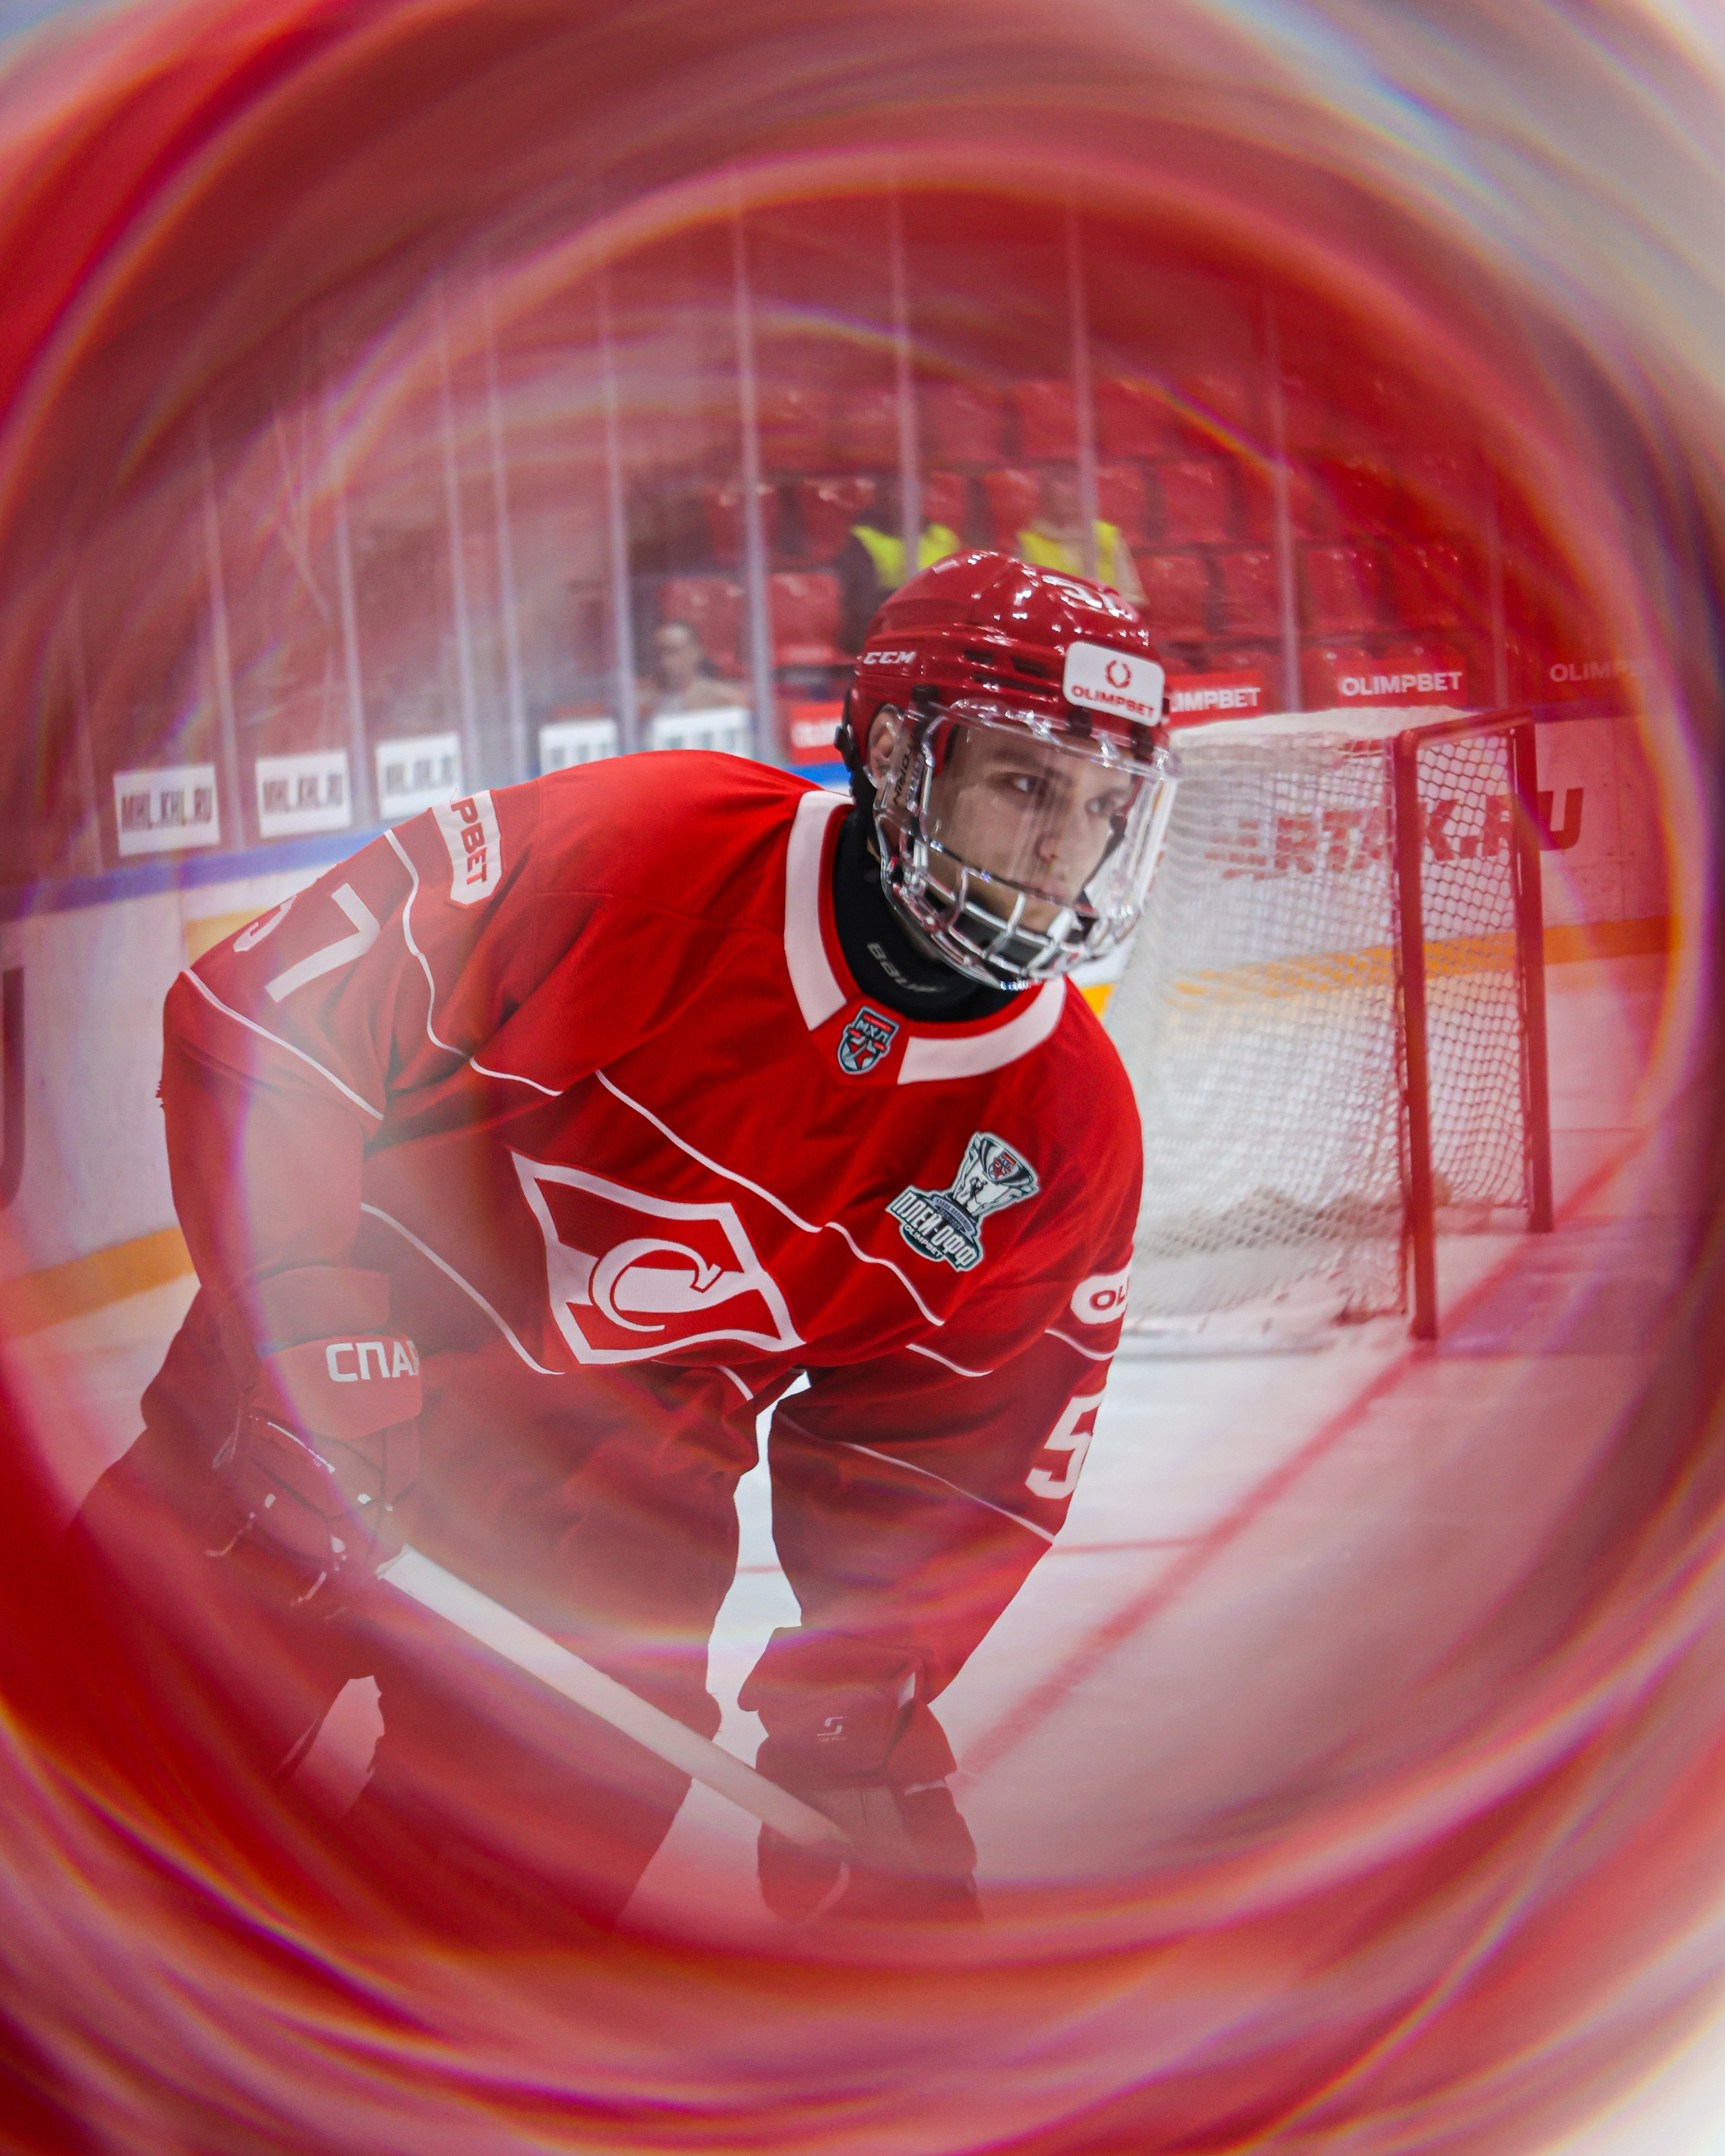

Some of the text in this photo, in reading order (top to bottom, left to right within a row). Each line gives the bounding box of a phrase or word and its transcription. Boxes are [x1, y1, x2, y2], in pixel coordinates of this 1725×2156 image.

[863, 651, 917, 665] CCM
[1548, 658, 1652, 683] OLIMP
[1342, 671, 1462, 697] OLIMPBET
[1072, 685, 1154, 717] OLIMPBET
[1170, 687, 1261, 712] IMPBET
[451, 797, 488, 885] PBET
[891, 1193, 977, 1266] ПЛЕЙ-ОФФ
[905, 1225, 942, 1258] OLIMPBET
